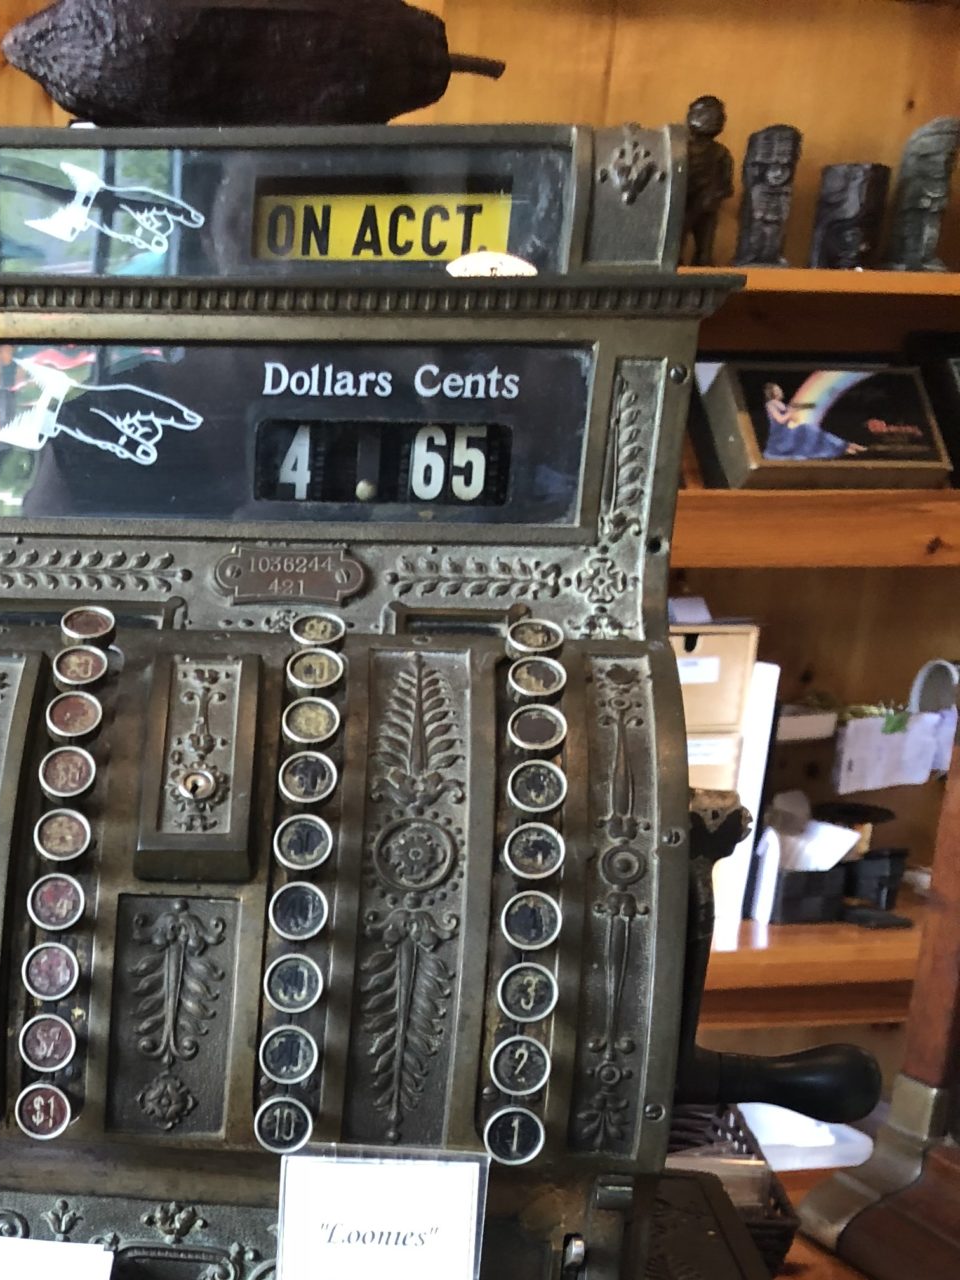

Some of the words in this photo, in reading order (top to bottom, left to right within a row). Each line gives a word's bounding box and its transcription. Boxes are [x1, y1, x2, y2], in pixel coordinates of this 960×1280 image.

[267, 204, 331, 256] ON
[262, 362, 392, 397] Dollars
[414, 364, 519, 398] Cents
[279, 425, 311, 500] 4
[411, 424, 488, 501] 65
[249, 556, 332, 573] 1036244
[268, 579, 305, 596] 421
[521, 976, 535, 1011] 3
[31, 1095, 56, 1128] $1
[272, 1107, 296, 1141] 10
[511, 1118, 520, 1152] 1
